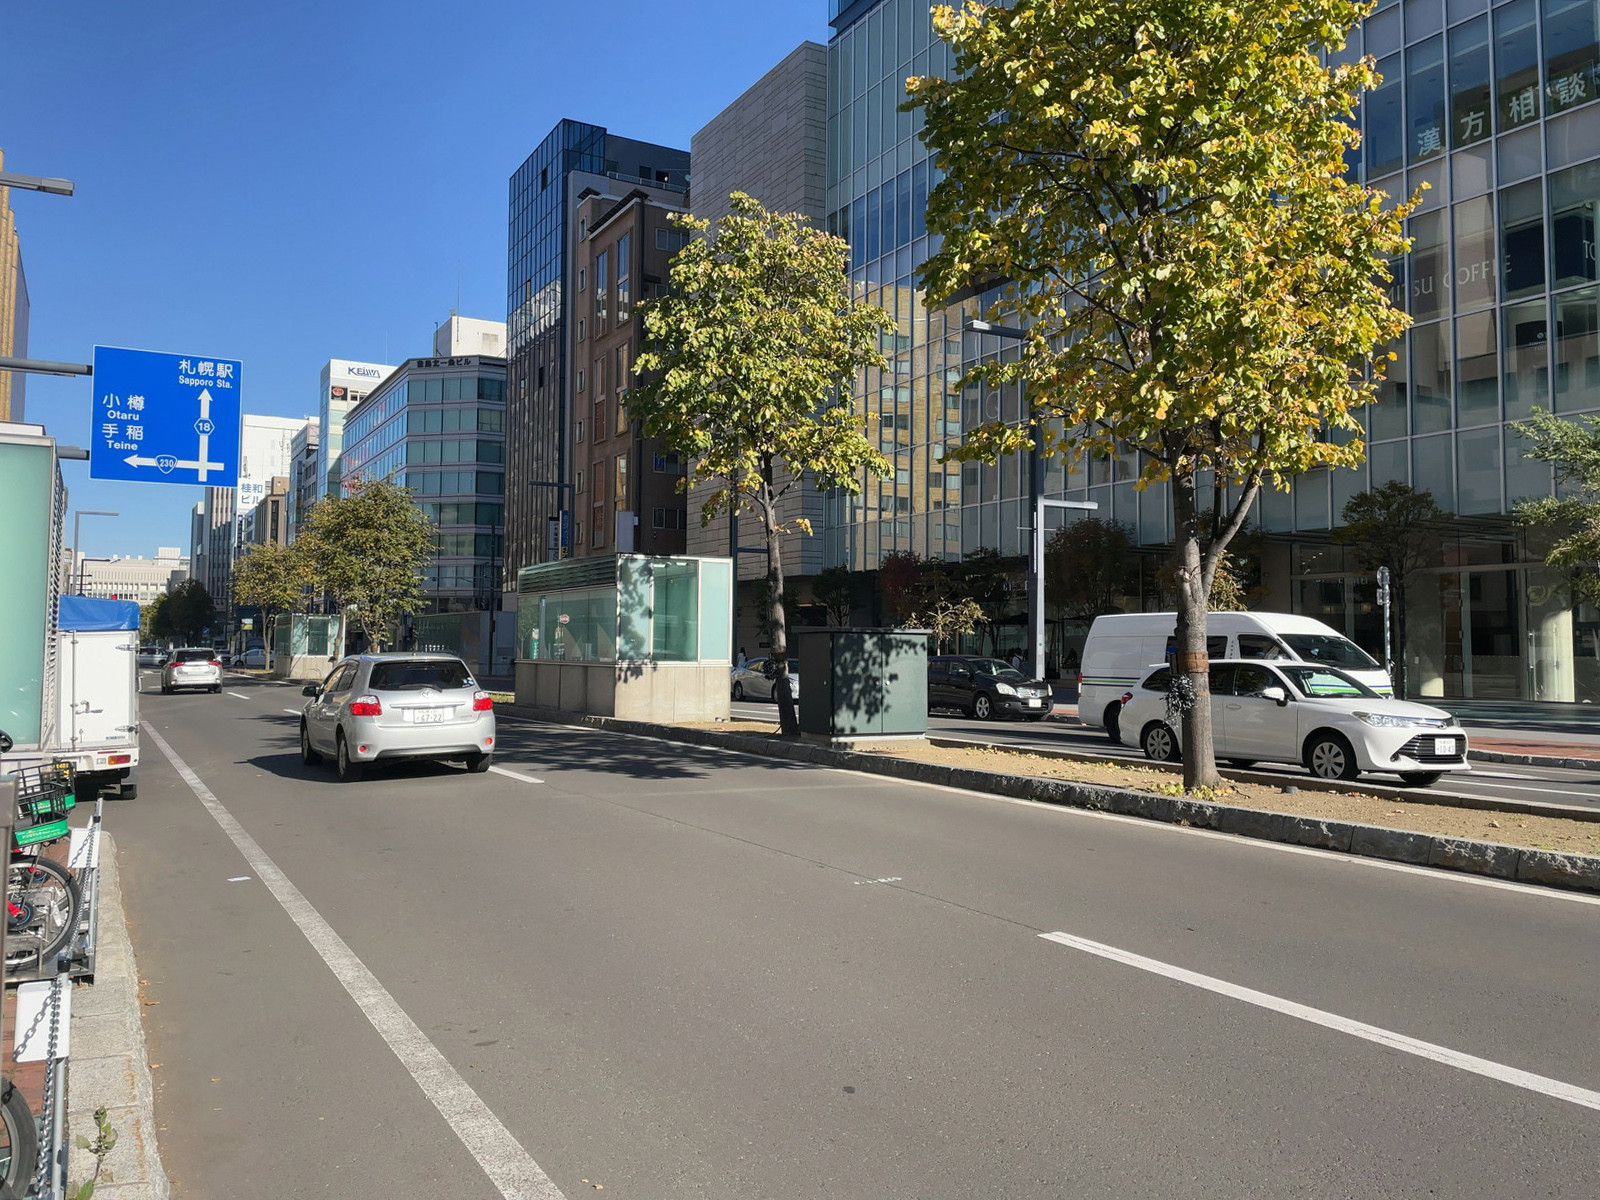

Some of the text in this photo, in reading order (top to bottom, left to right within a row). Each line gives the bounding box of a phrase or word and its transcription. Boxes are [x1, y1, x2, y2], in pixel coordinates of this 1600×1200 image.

[1417, 71, 1587, 157] 漢方相談
[178, 358, 234, 379] 札幌駅
[178, 375, 233, 389] Sapporo Sta.
[102, 393, 145, 411] 小樽
[107, 410, 140, 421] Otaru
[102, 423, 144, 440] 手稲
[198, 422, 211, 432] 18
[106, 440, 139, 451] Teine
[159, 458, 174, 468] 230
[241, 483, 263, 494] 桂和
